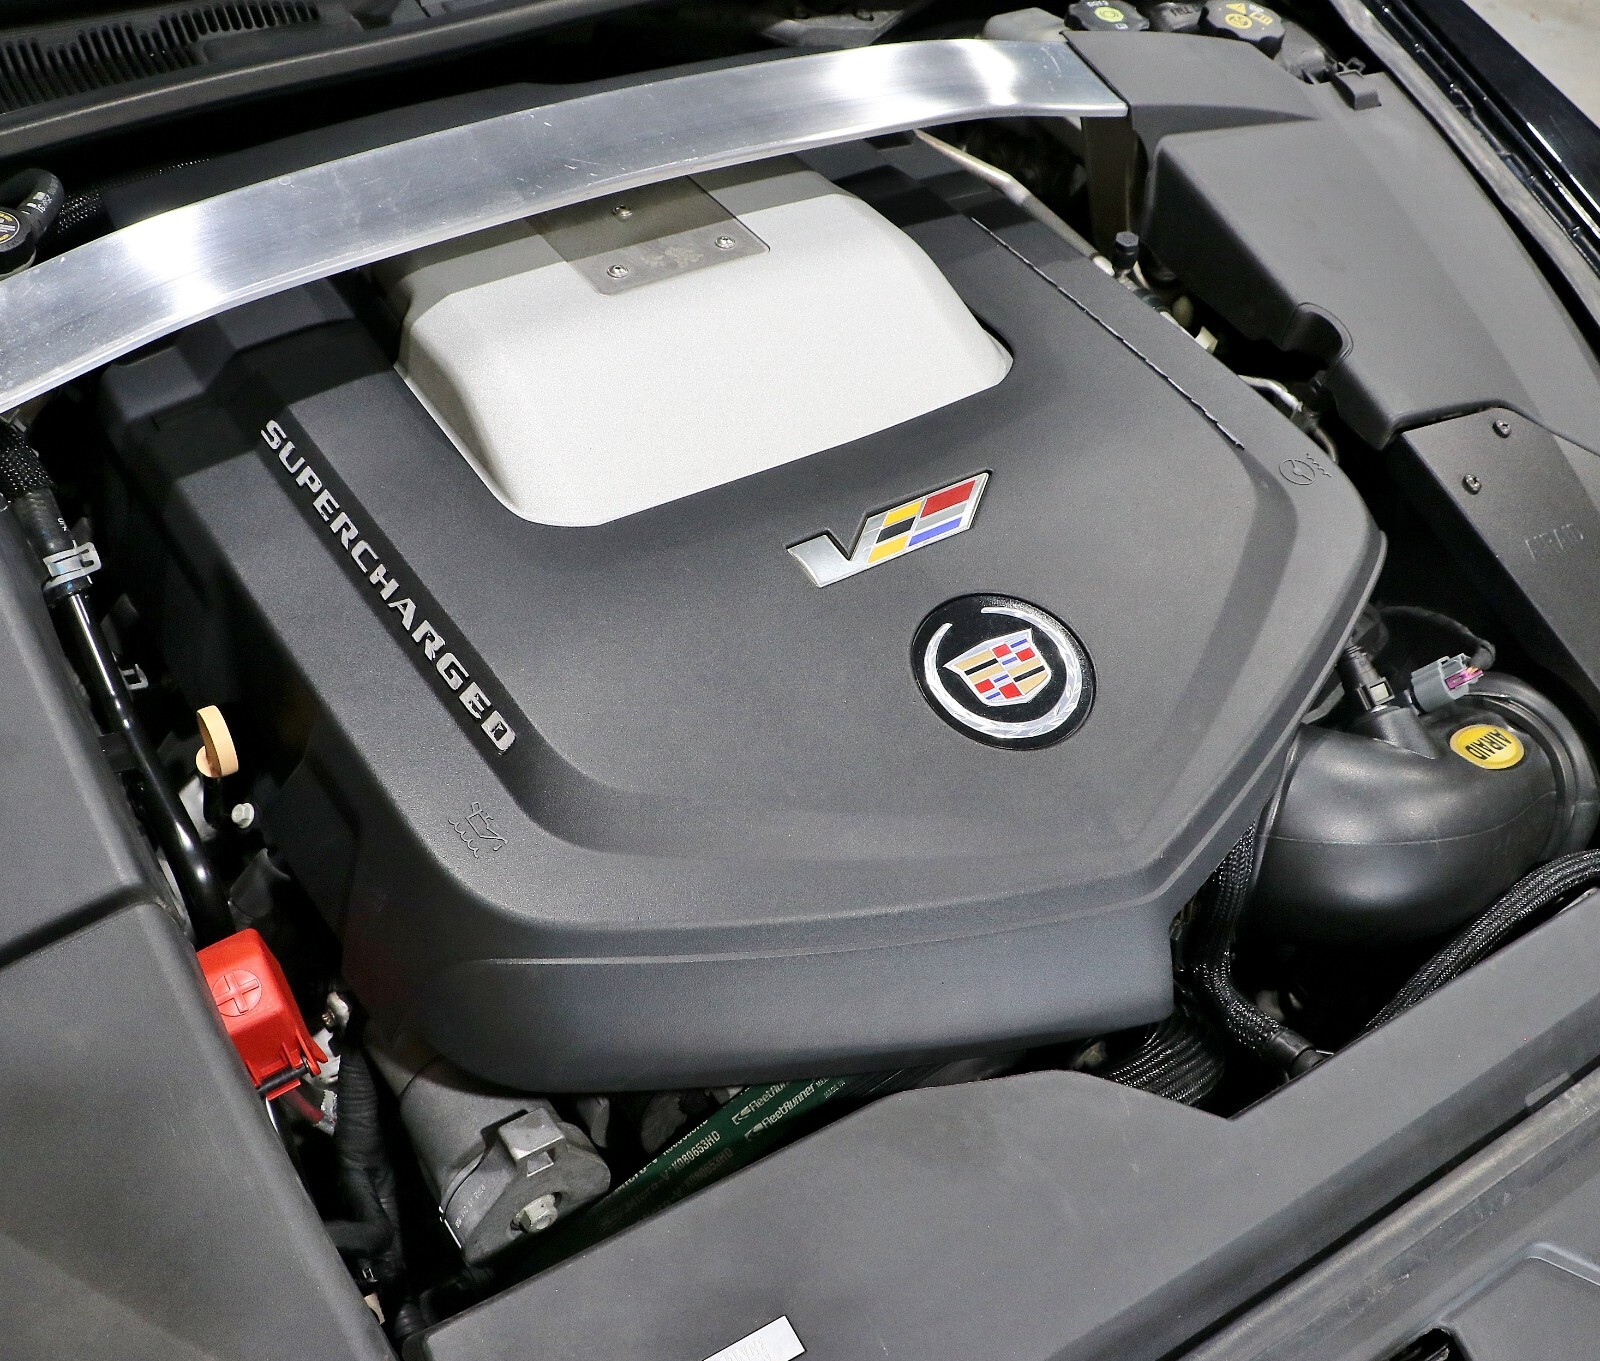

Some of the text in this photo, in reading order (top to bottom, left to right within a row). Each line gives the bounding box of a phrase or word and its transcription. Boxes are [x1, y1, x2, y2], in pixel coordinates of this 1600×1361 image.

[261, 419, 517, 754] SUPERCHARGED
[1465, 728, 1512, 760] AIRAID
[761, 1083, 816, 1129] FleetRunner
[671, 1130, 721, 1173] K080653HD
